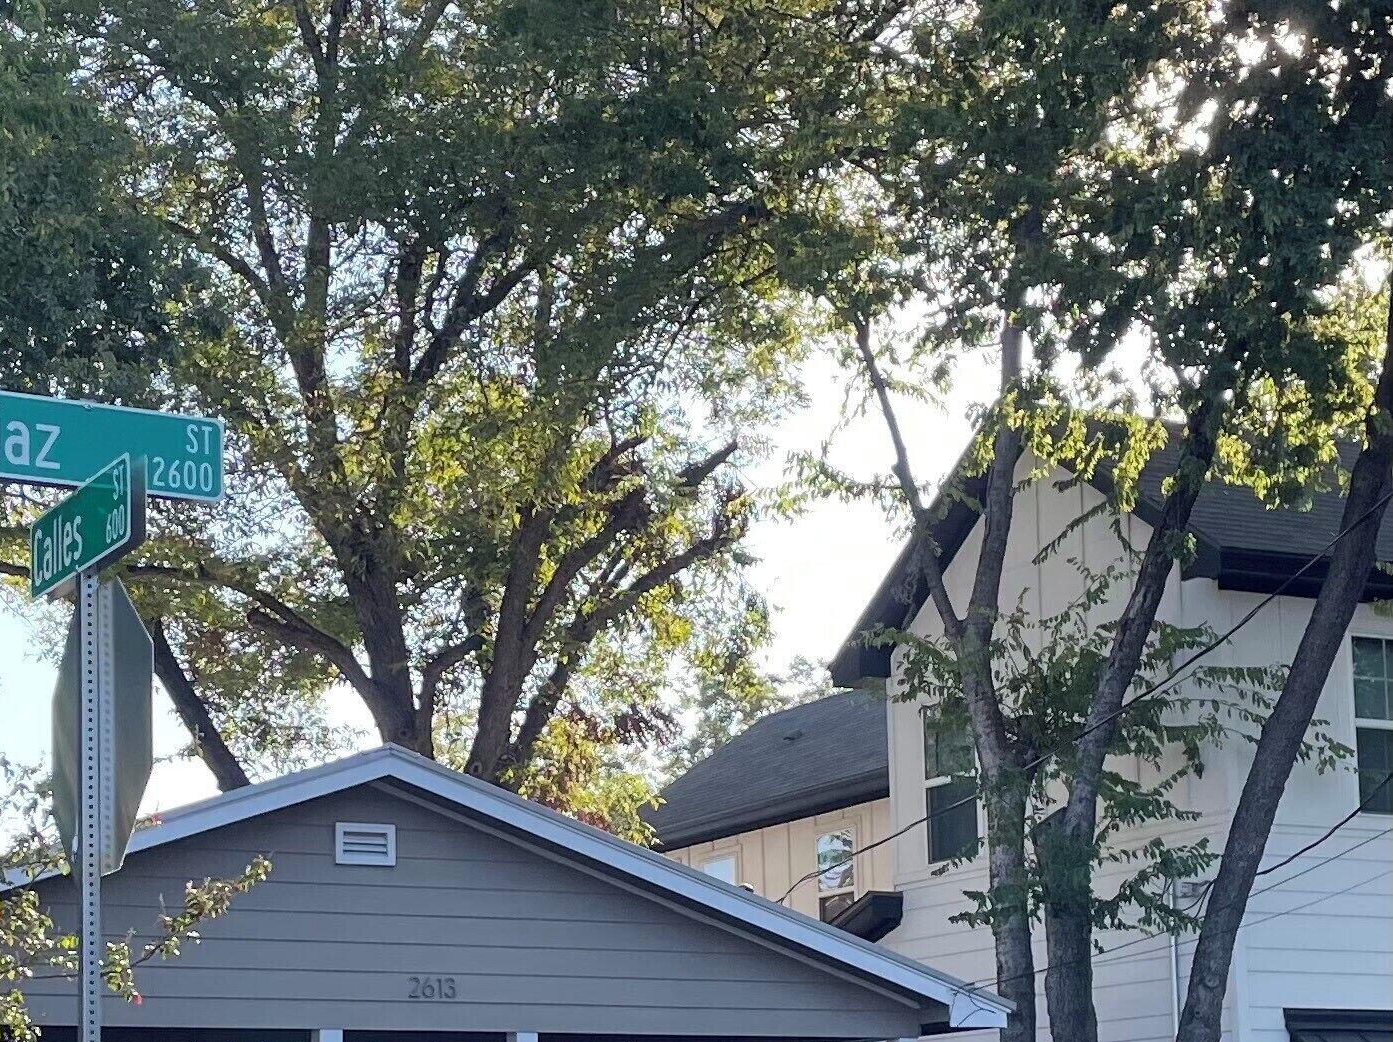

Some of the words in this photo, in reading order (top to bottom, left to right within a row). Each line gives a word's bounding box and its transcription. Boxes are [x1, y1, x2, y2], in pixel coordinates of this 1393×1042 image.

[186, 424, 212, 455] ST
[153, 457, 213, 492] 2600
[33, 515, 83, 587] Calles
[113, 464, 124, 500] ST
[106, 504, 125, 544] 600
[407, 977, 456, 999] 2613
